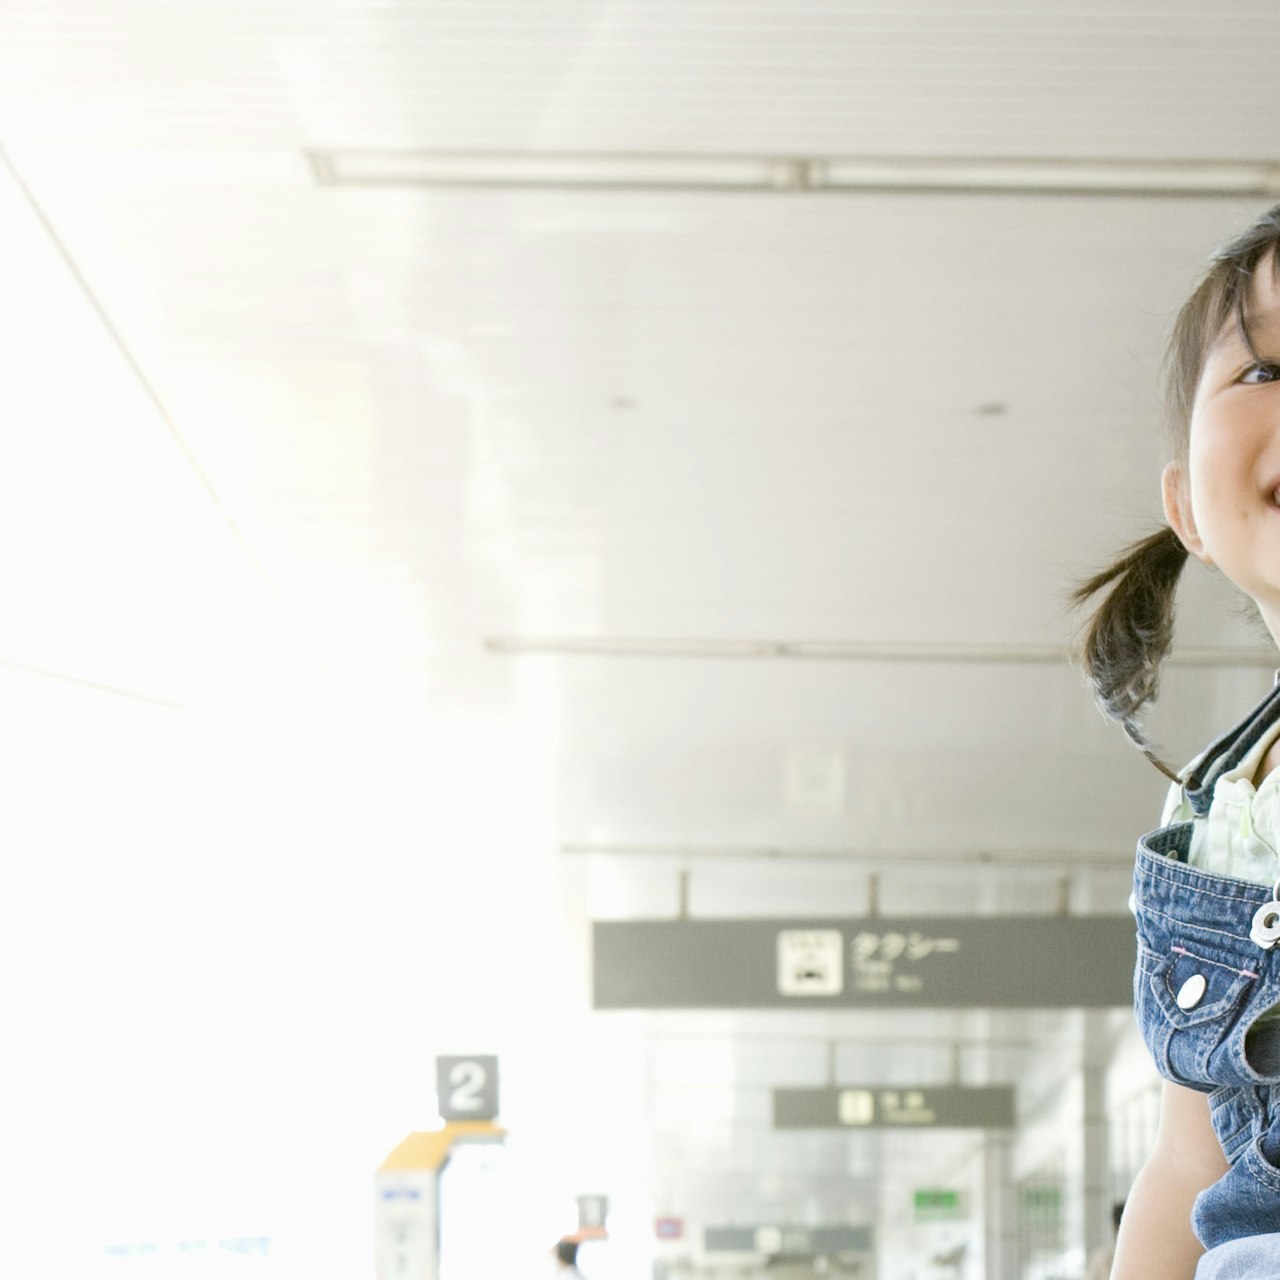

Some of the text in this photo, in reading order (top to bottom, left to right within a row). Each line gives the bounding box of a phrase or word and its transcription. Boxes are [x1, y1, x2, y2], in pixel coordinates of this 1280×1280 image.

[852, 931, 959, 961] タクシー
[449, 1061, 486, 1112] 2
